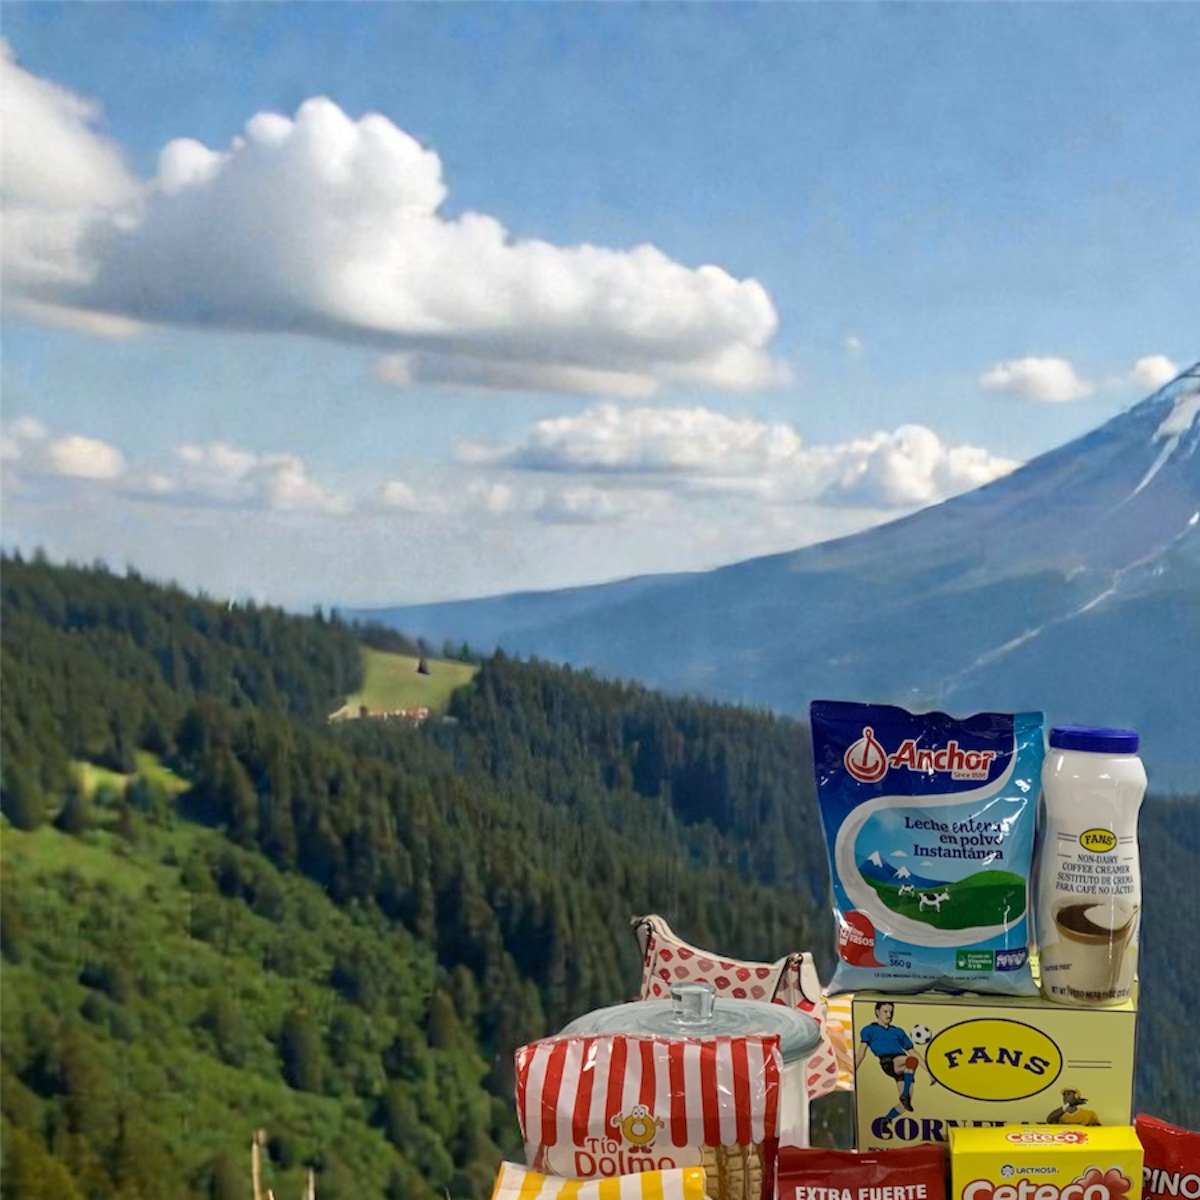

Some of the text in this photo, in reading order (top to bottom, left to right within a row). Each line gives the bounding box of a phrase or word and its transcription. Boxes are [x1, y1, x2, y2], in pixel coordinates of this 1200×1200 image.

[889, 742, 996, 771] Anchor
[905, 817, 949, 833] Leche
[939, 833, 1004, 848] en polvo
[1084, 834, 1113, 846] FANS
[914, 844, 1004, 860] Instantánea
[1076, 853, 1119, 865] NON-DAIRY
[1062, 861, 1130, 875] COFFEE CREAMER
[1057, 871, 1100, 885] SUSTITUTO
[1101, 874, 1112, 885] DE
[1055, 881, 1075, 894] PARA
[1076, 884, 1097, 895] CAFÉ
[1098, 885, 1110, 895] NO
[944, 1047, 1050, 1077] FANS
[1006, 1131, 1079, 1143] Ceteco
[586, 1138, 617, 1155] Tío
[575, 1151, 676, 1178] Dolmo
